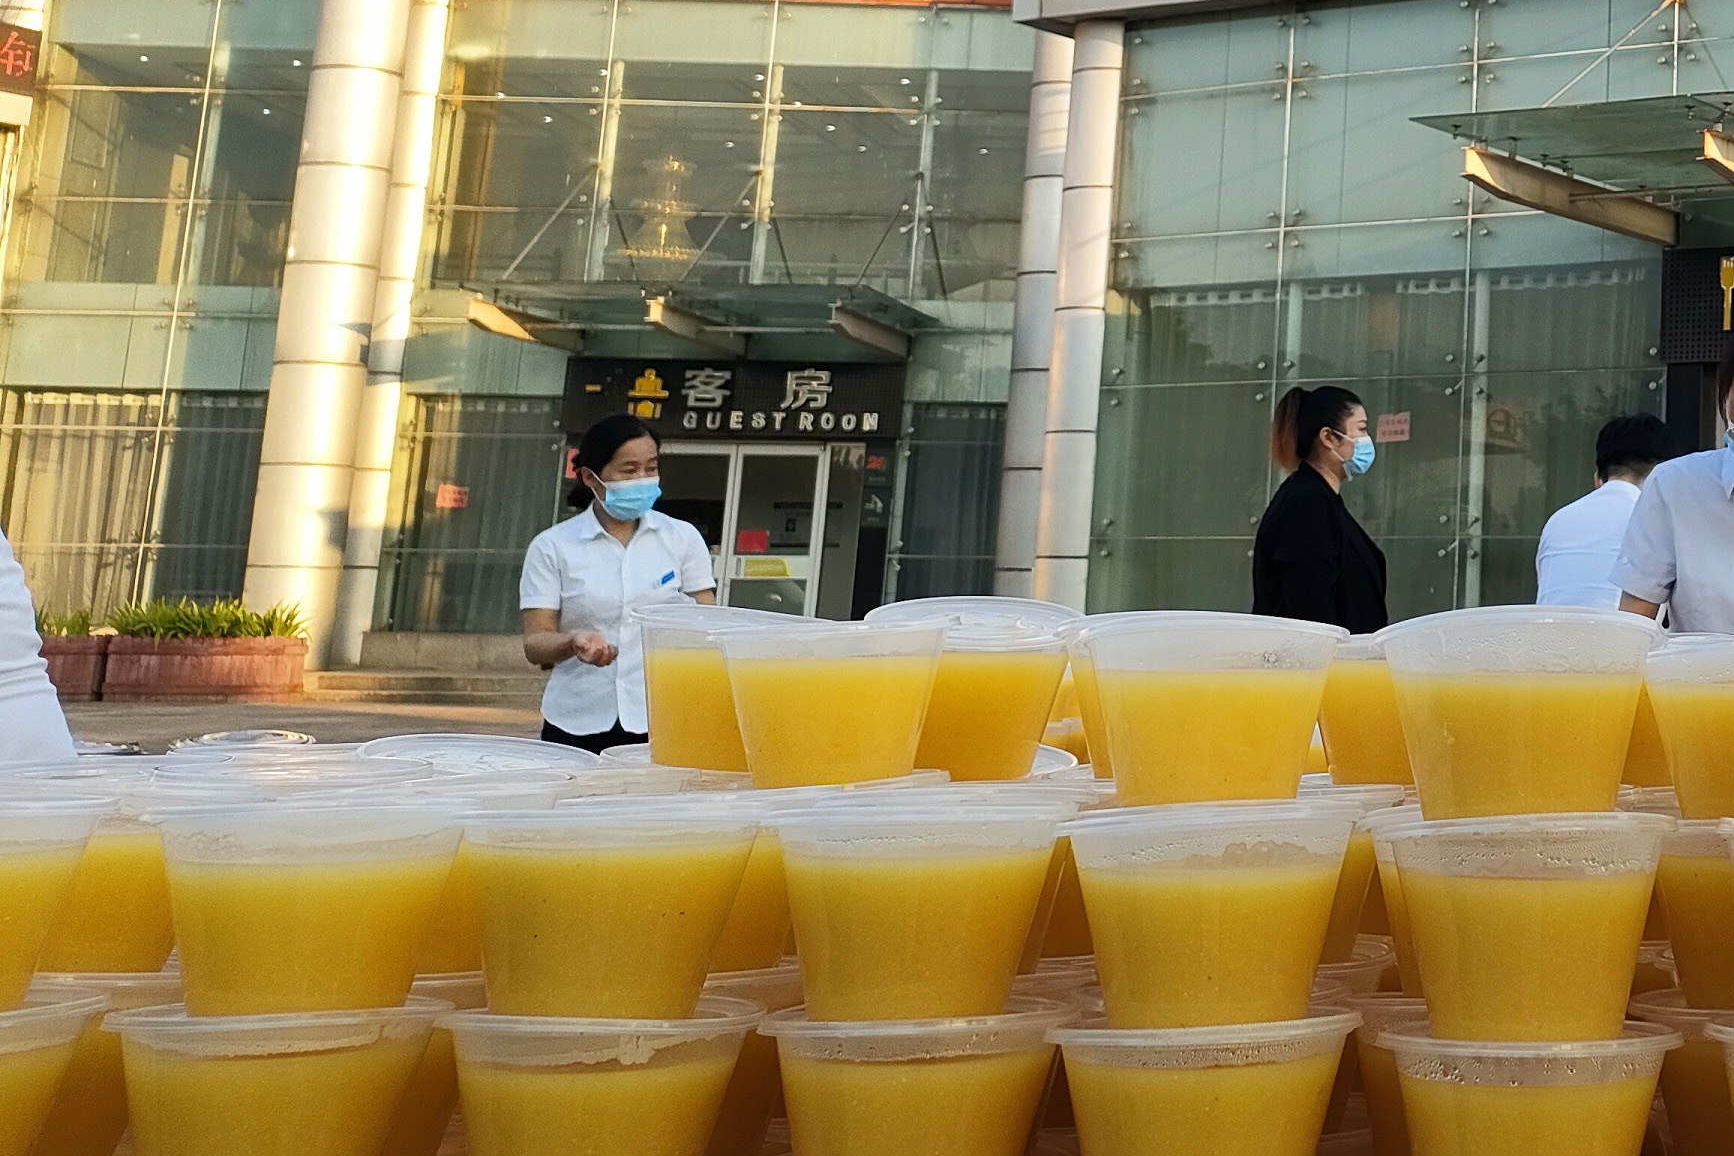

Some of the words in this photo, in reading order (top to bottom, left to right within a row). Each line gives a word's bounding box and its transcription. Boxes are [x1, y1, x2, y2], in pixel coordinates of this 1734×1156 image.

[681, 367, 833, 411] 客房
[683, 410, 787, 432] GUEST
[799, 411, 880, 432] ROOM
